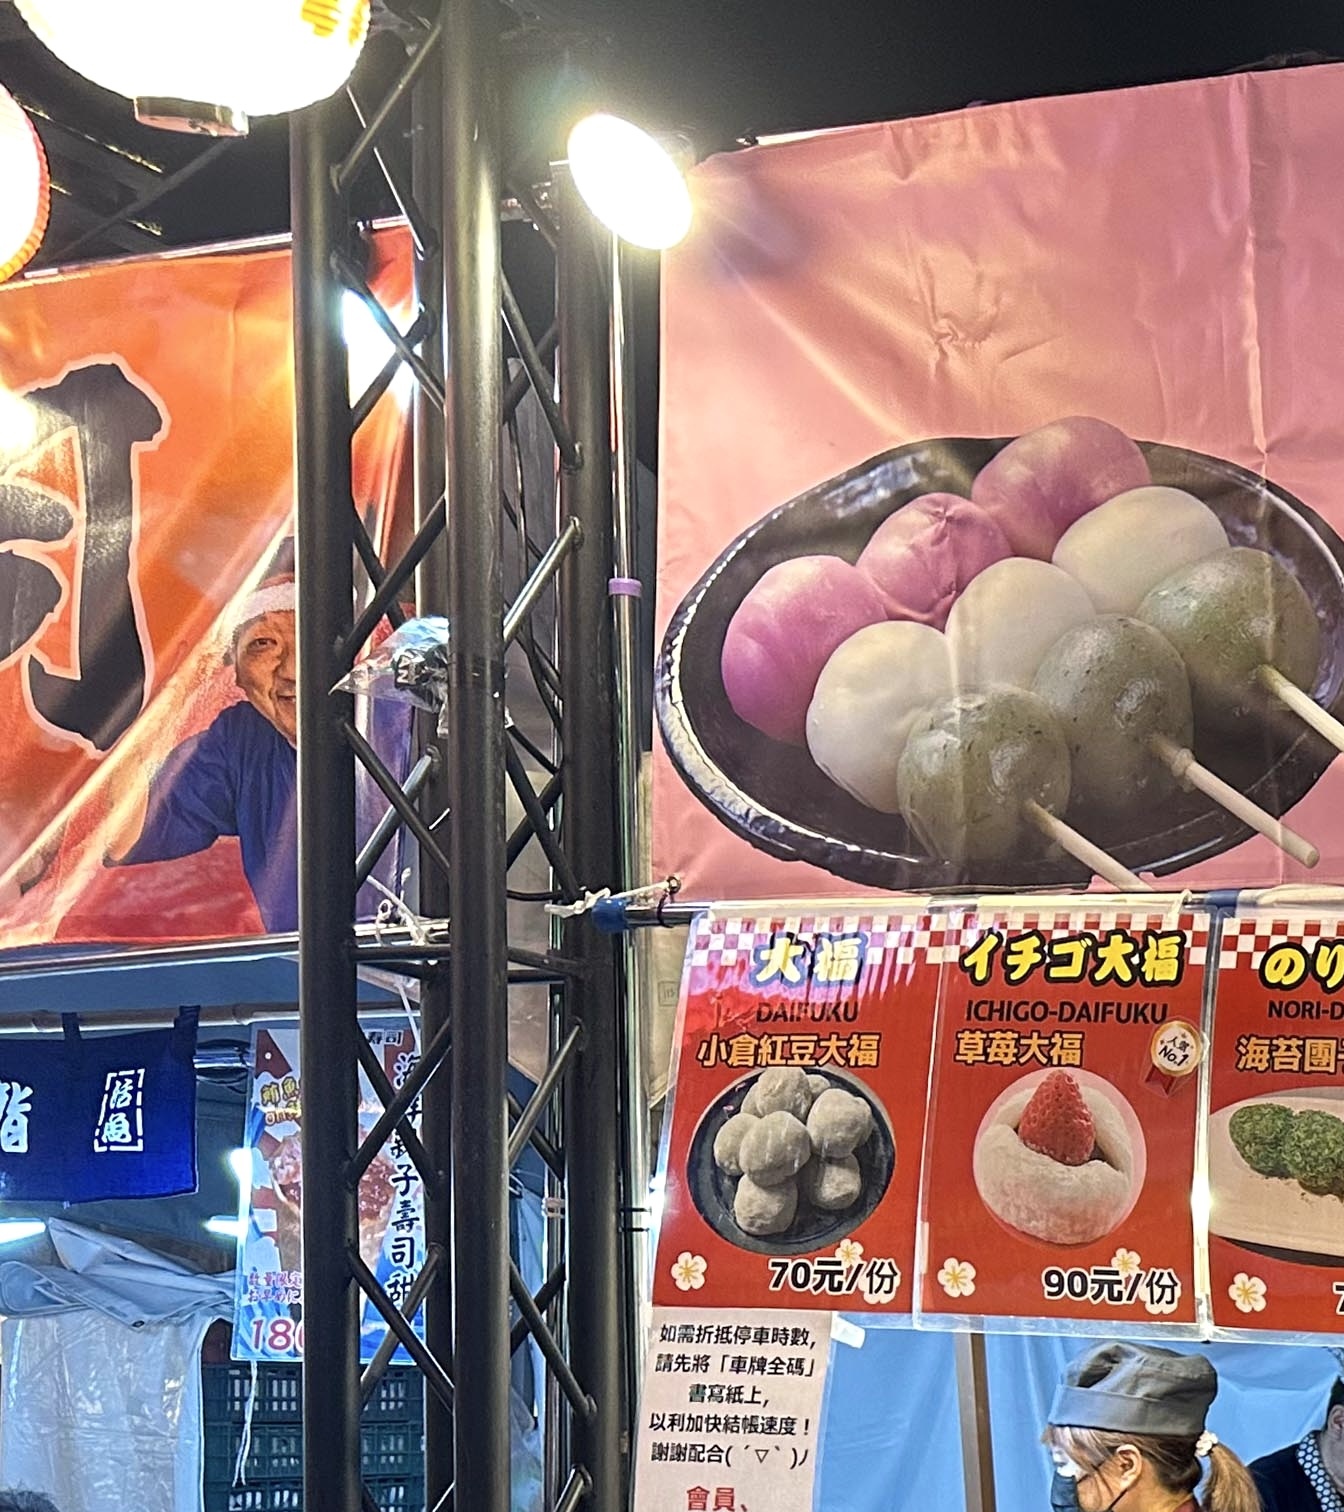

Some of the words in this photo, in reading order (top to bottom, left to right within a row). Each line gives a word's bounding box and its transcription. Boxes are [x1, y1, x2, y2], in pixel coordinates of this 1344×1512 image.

[755, 932, 865, 982] 大福
[963, 931, 1187, 984] イチゴ大福
[756, 1002, 860, 1023] DAIFUKU
[965, 1002, 1168, 1023] ICHIGO-DAIFUKU
[699, 1035, 880, 1068] 小倉紅豆大福
[1158, 1047, 1190, 1067] No.1
[769, 1260, 898, 1295] 70元/份
[1044, 1270, 1178, 1305] 90元/份
